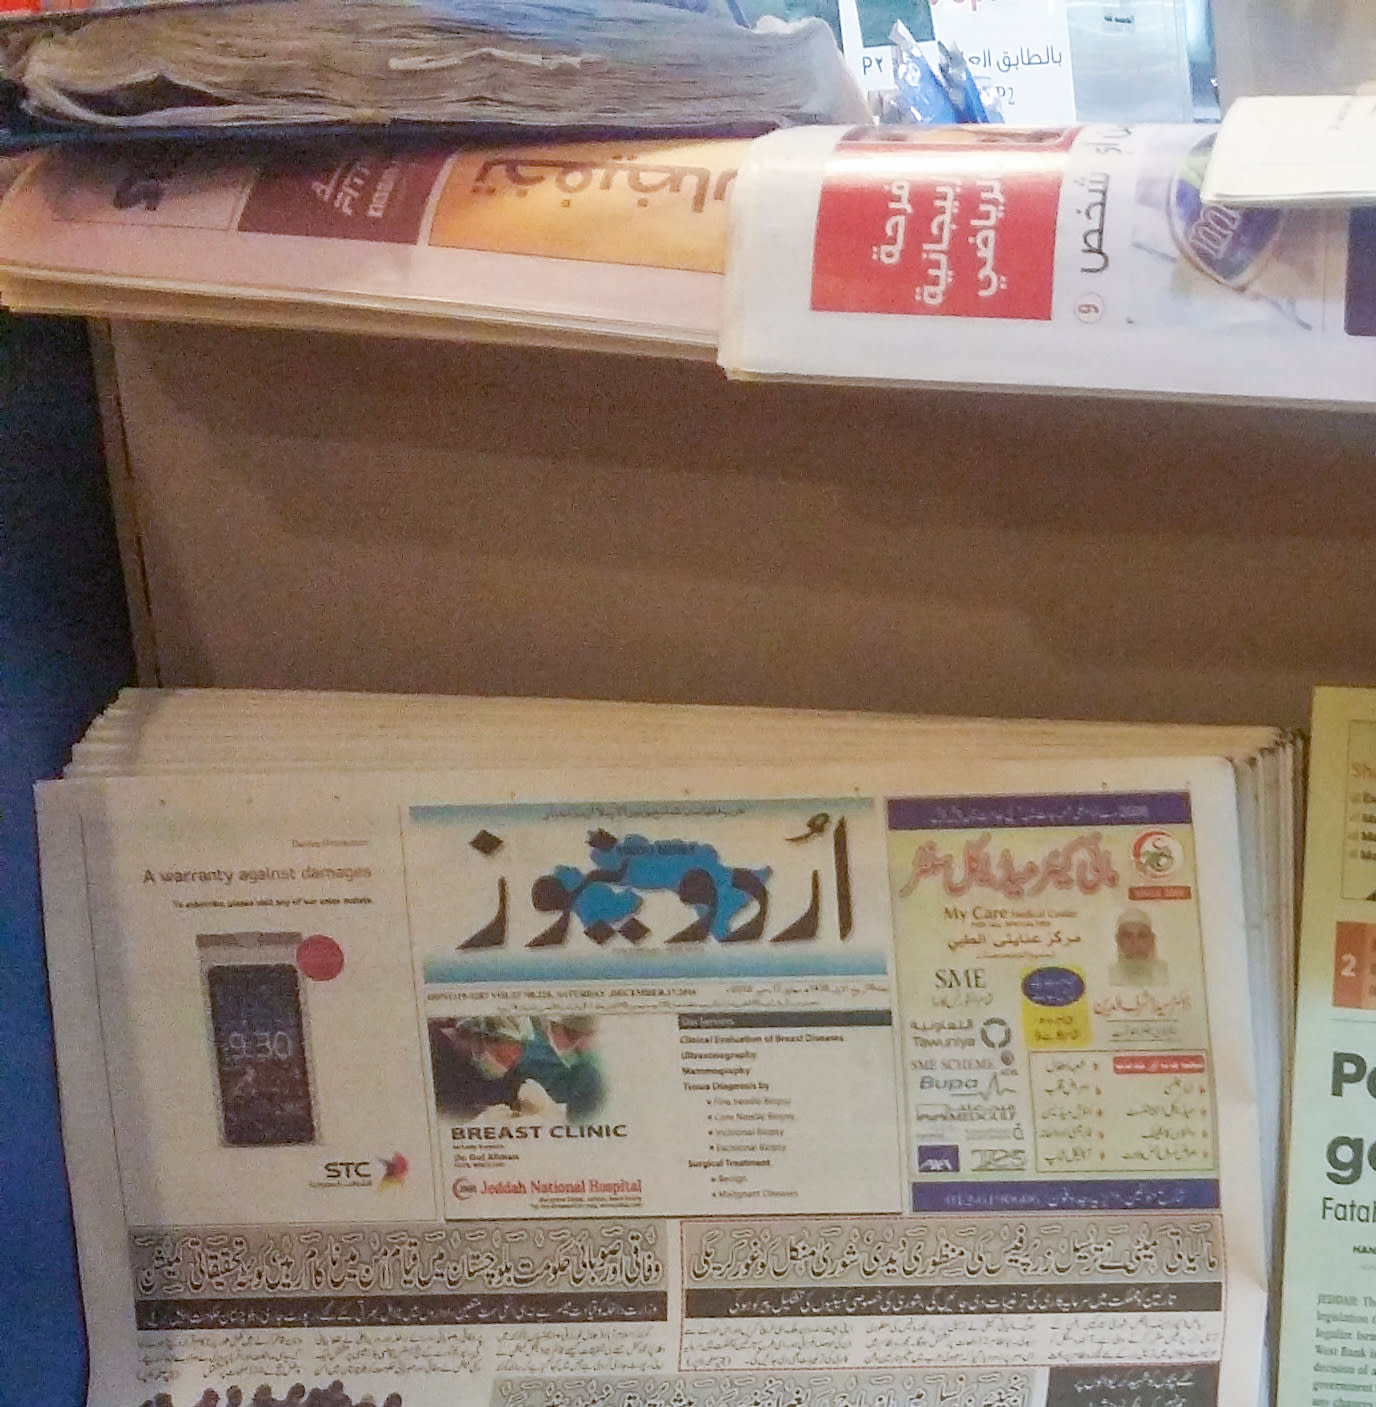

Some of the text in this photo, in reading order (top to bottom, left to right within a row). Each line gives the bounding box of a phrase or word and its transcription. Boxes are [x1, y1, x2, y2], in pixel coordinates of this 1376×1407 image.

[143, 870, 155, 883] A
[1341, 954, 1357, 977] 2
[935, 968, 986, 988] SME
[451, 1124, 628, 1140] BREAST CLINIC
[324, 1161, 372, 1179] STC
[481, 1179, 642, 1195] Jeddah National Hospital
